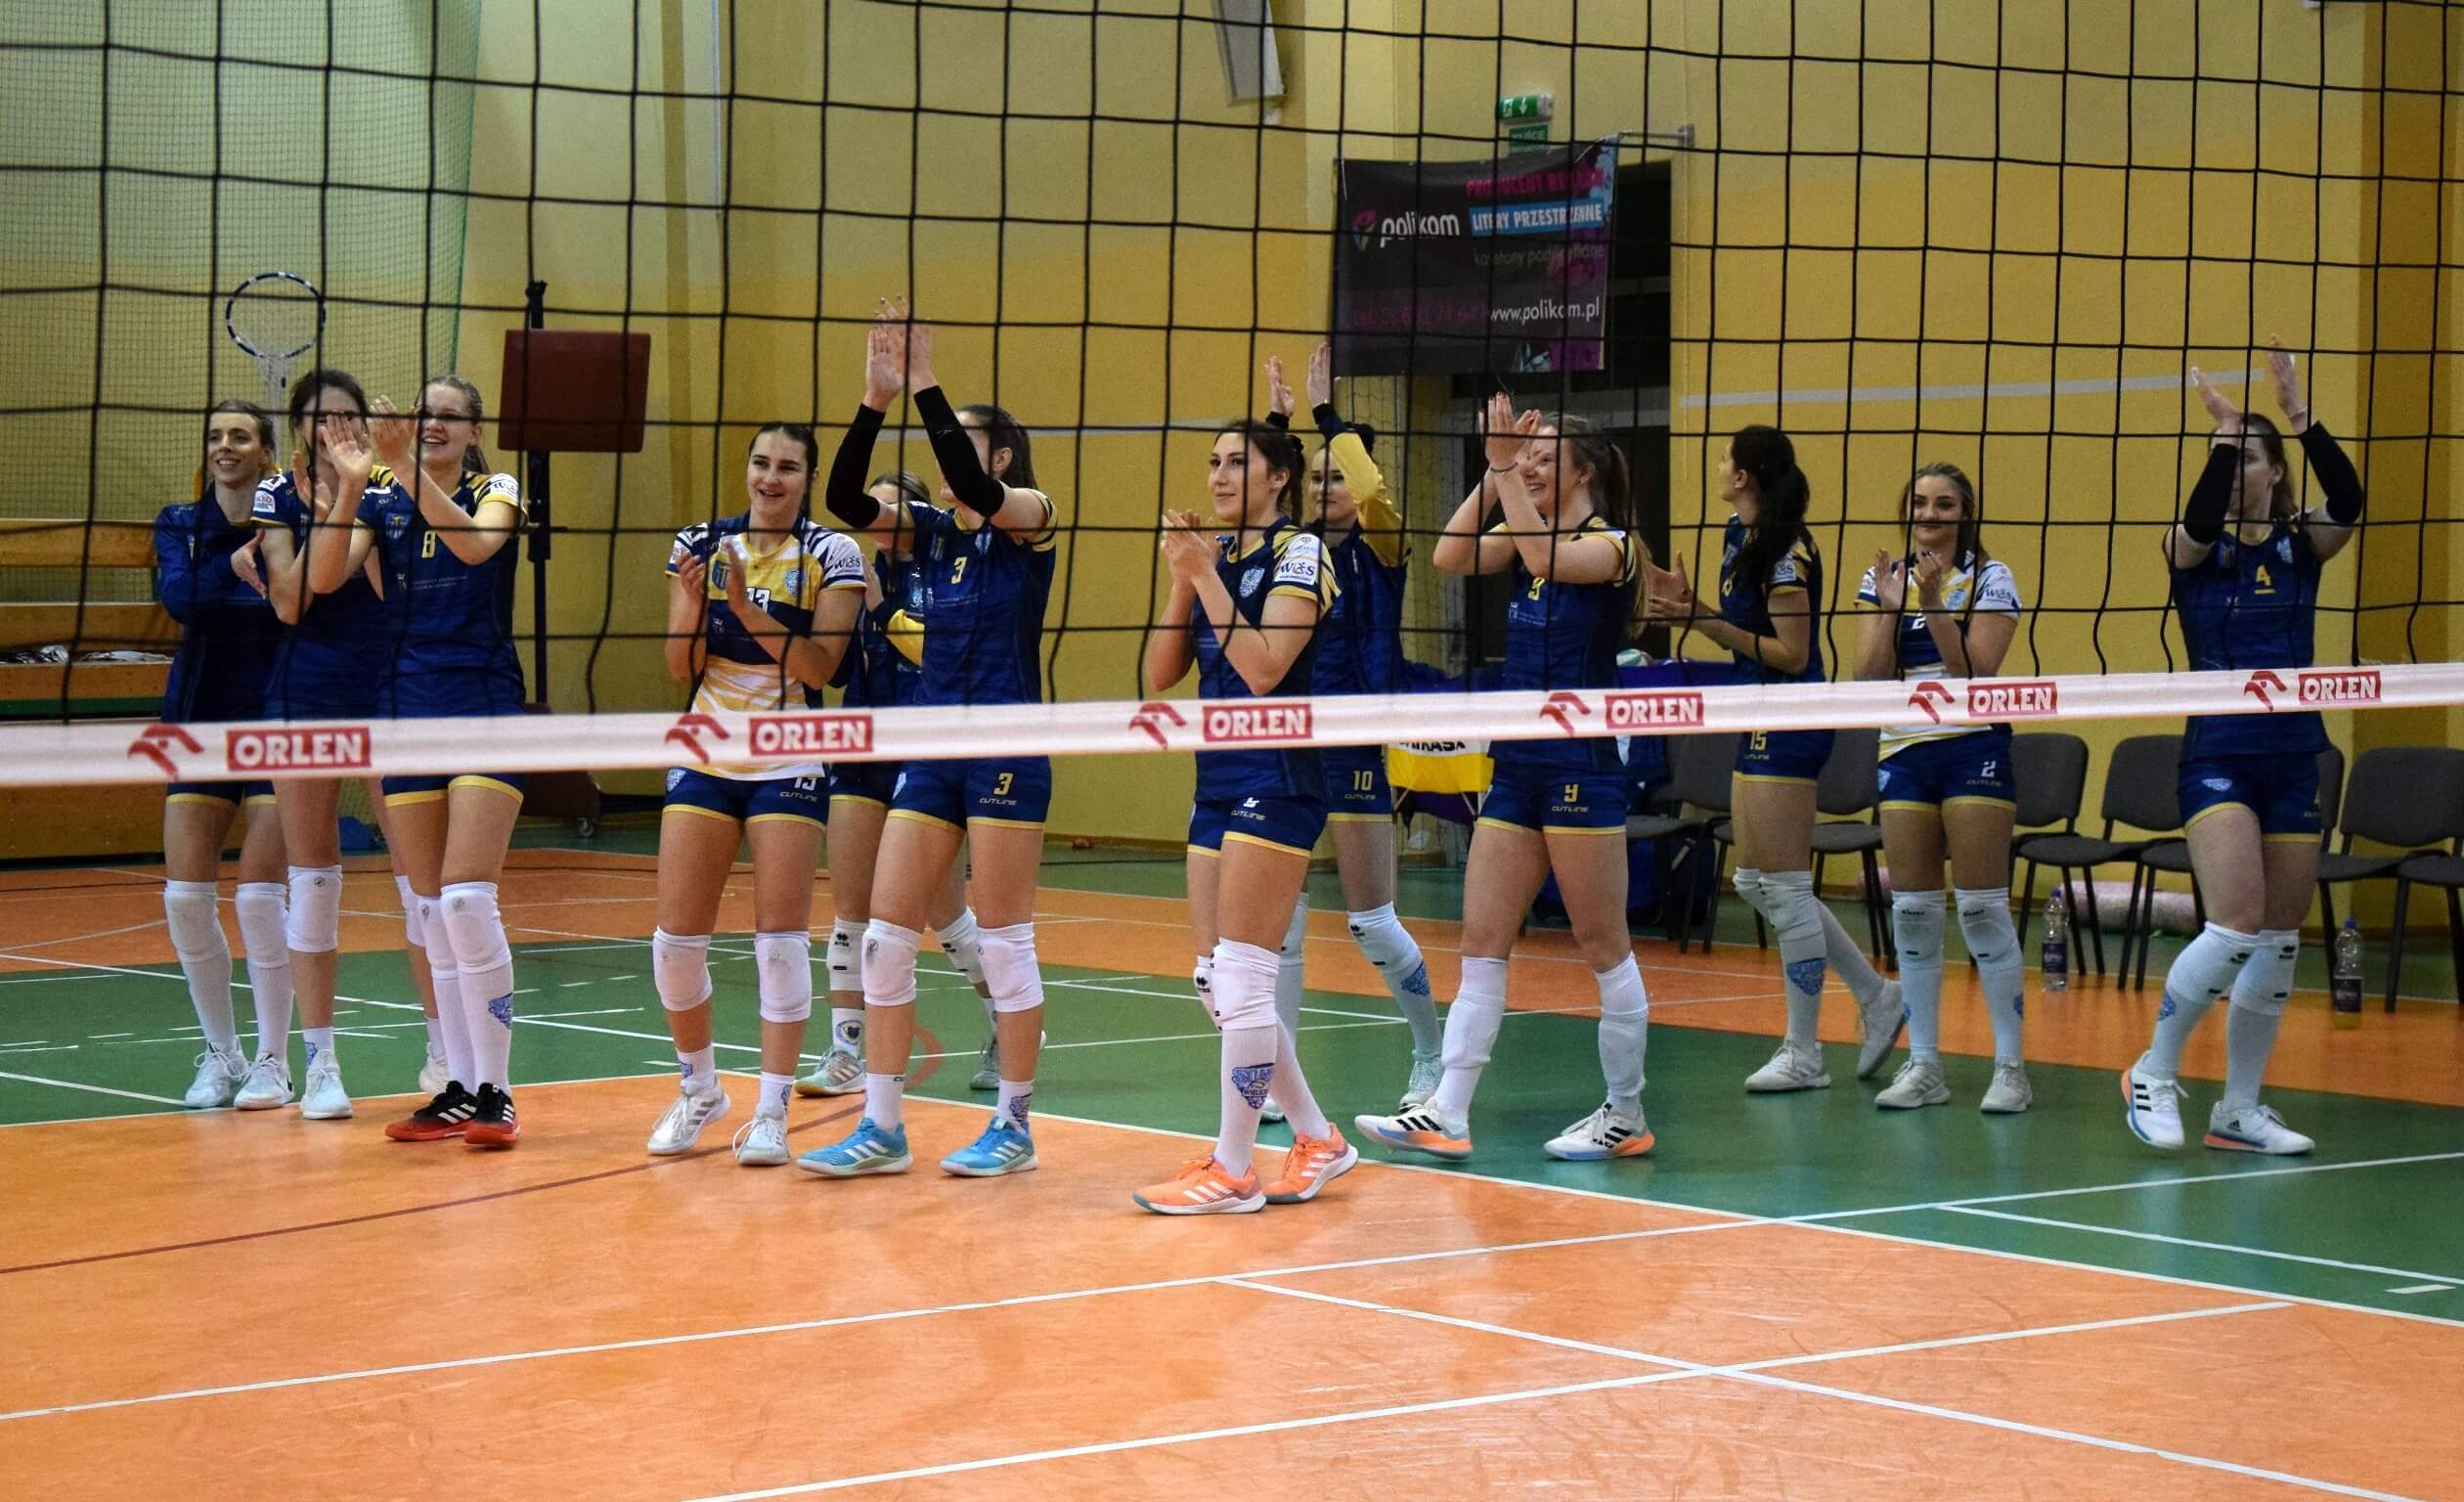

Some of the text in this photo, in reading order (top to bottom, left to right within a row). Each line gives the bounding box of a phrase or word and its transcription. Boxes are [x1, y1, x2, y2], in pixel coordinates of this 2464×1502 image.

[1380, 211, 1460, 248] polikom
[422, 530, 437, 558] 8
[950, 555, 969, 585] 3
[2255, 564, 2272, 587] 4
[1972, 687, 2052, 713] ORLEN
[2303, 677, 2377, 701] ORLEN
[1209, 708, 1306, 737] ORLEN
[1610, 697, 1698, 725] ORLEN
[756, 720, 866, 751] ORLEN
[234, 733, 363, 767] ORLEN
[1353, 770, 1374, 791] 10
[1980, 760, 1997, 777] 2
[993, 772, 1014, 796] 3
[979, 797, 1018, 807] CUTLINE
